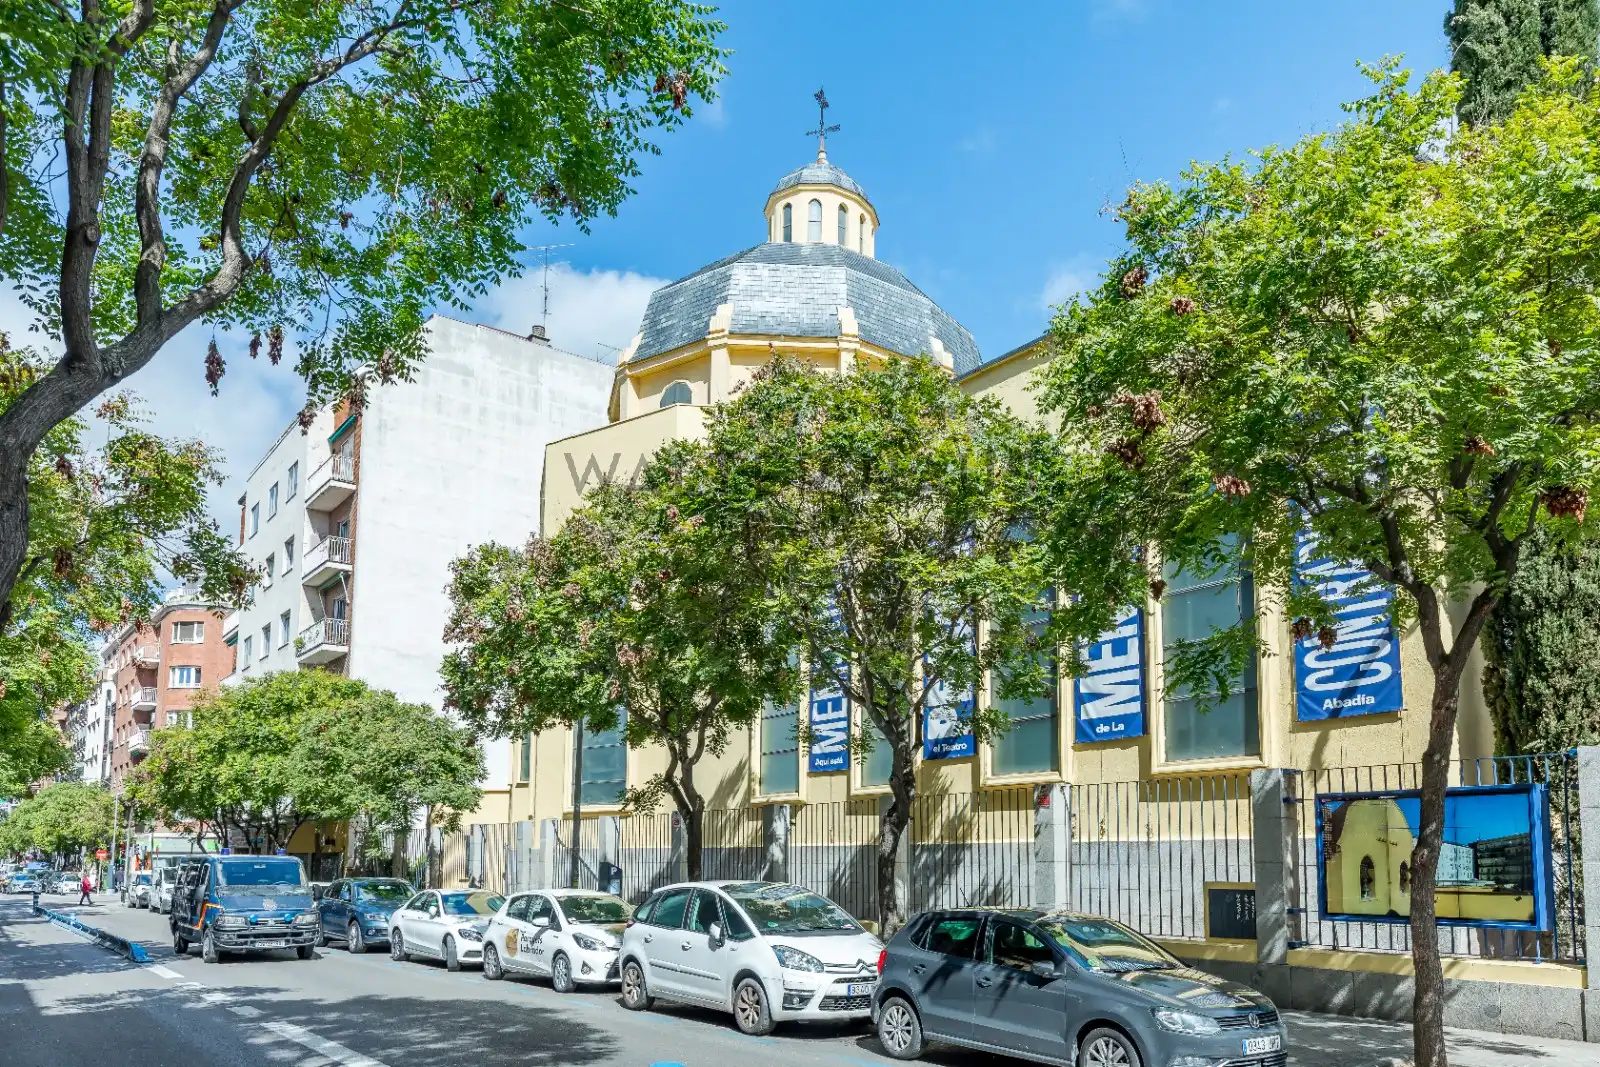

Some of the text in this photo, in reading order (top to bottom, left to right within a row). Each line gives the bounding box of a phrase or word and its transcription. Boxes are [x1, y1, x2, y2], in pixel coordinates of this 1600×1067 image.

[1322, 694, 1375, 711] Abadía
[1095, 721, 1125, 734] de La
[932, 742, 968, 753] el Teatro
[610, 866, 618, 875] P
